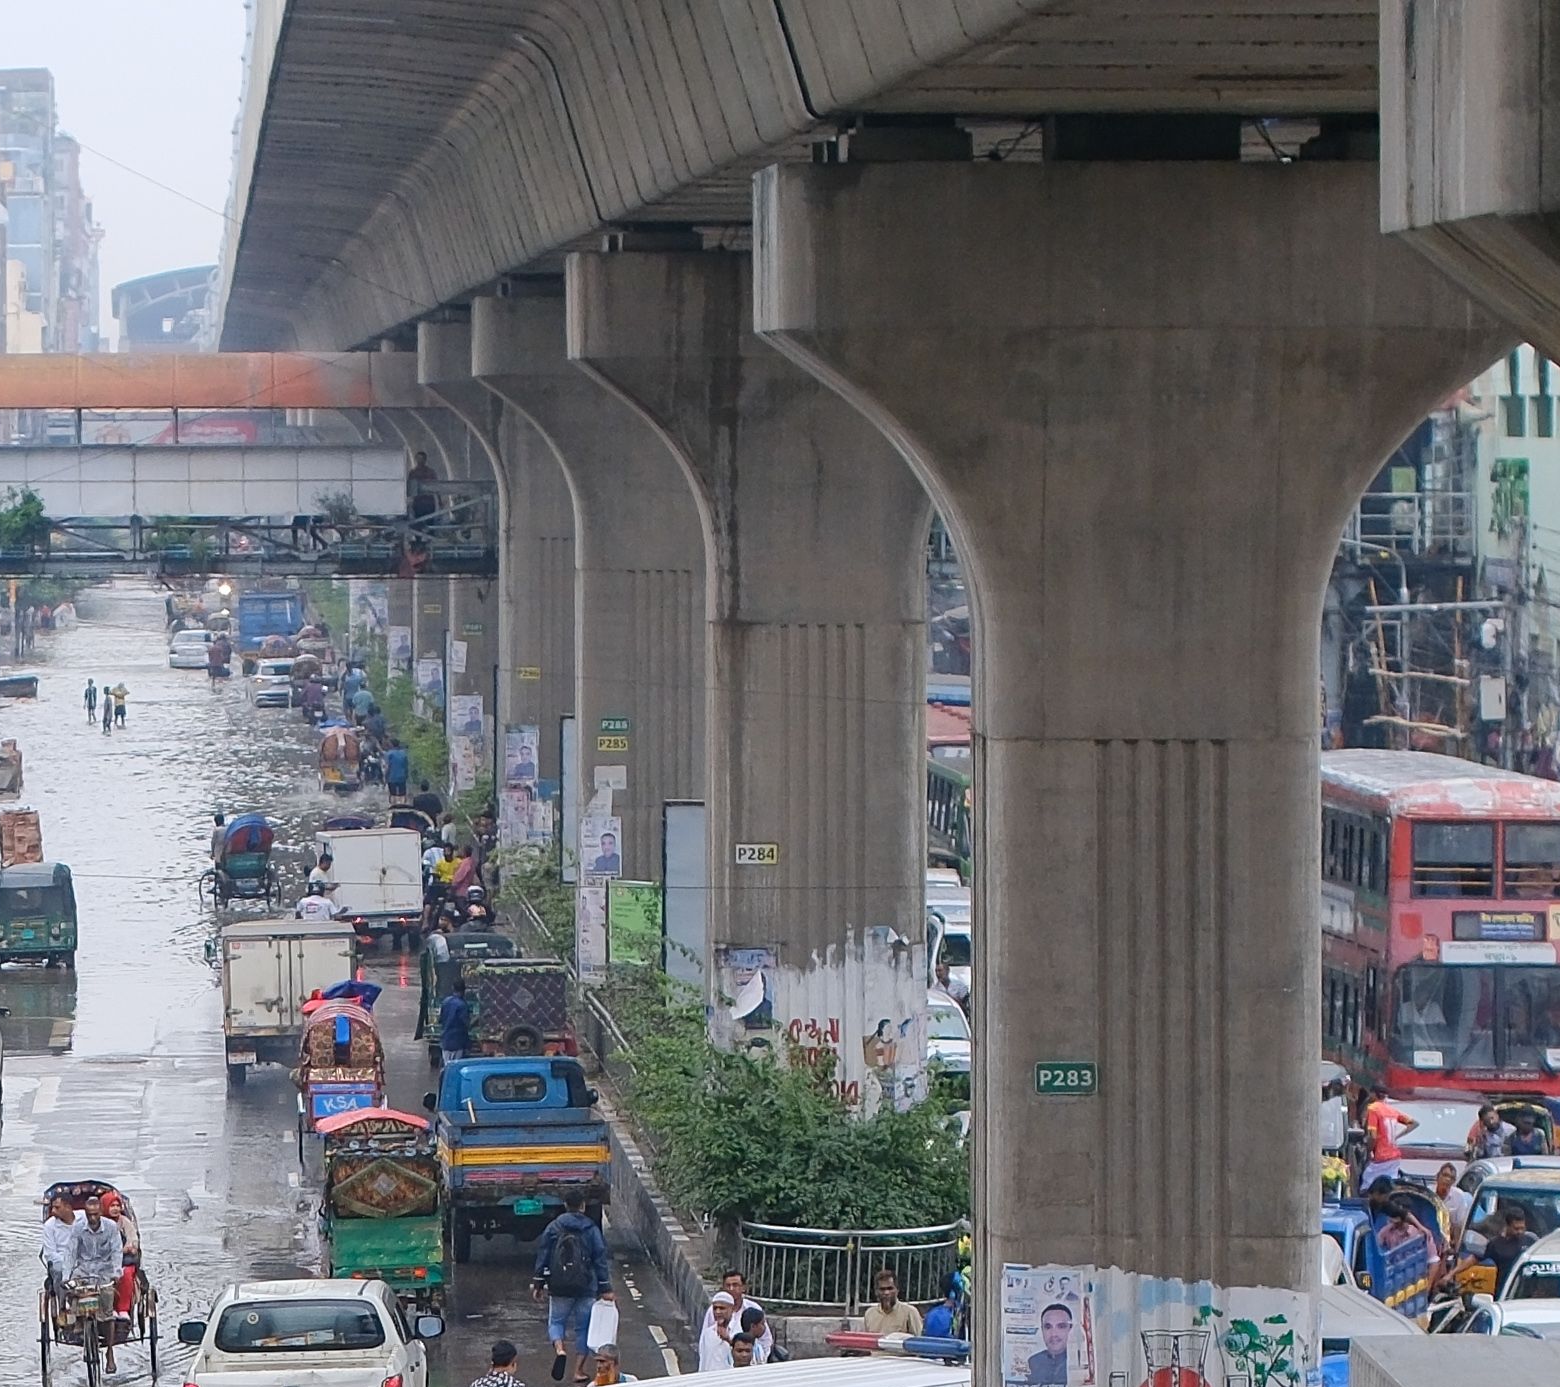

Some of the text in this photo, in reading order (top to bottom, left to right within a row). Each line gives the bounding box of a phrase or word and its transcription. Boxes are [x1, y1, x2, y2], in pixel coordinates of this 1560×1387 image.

[737, 846, 774, 861] P284
[1038, 1068, 1093, 1088] P283
[323, 1096, 357, 1113] KSA
